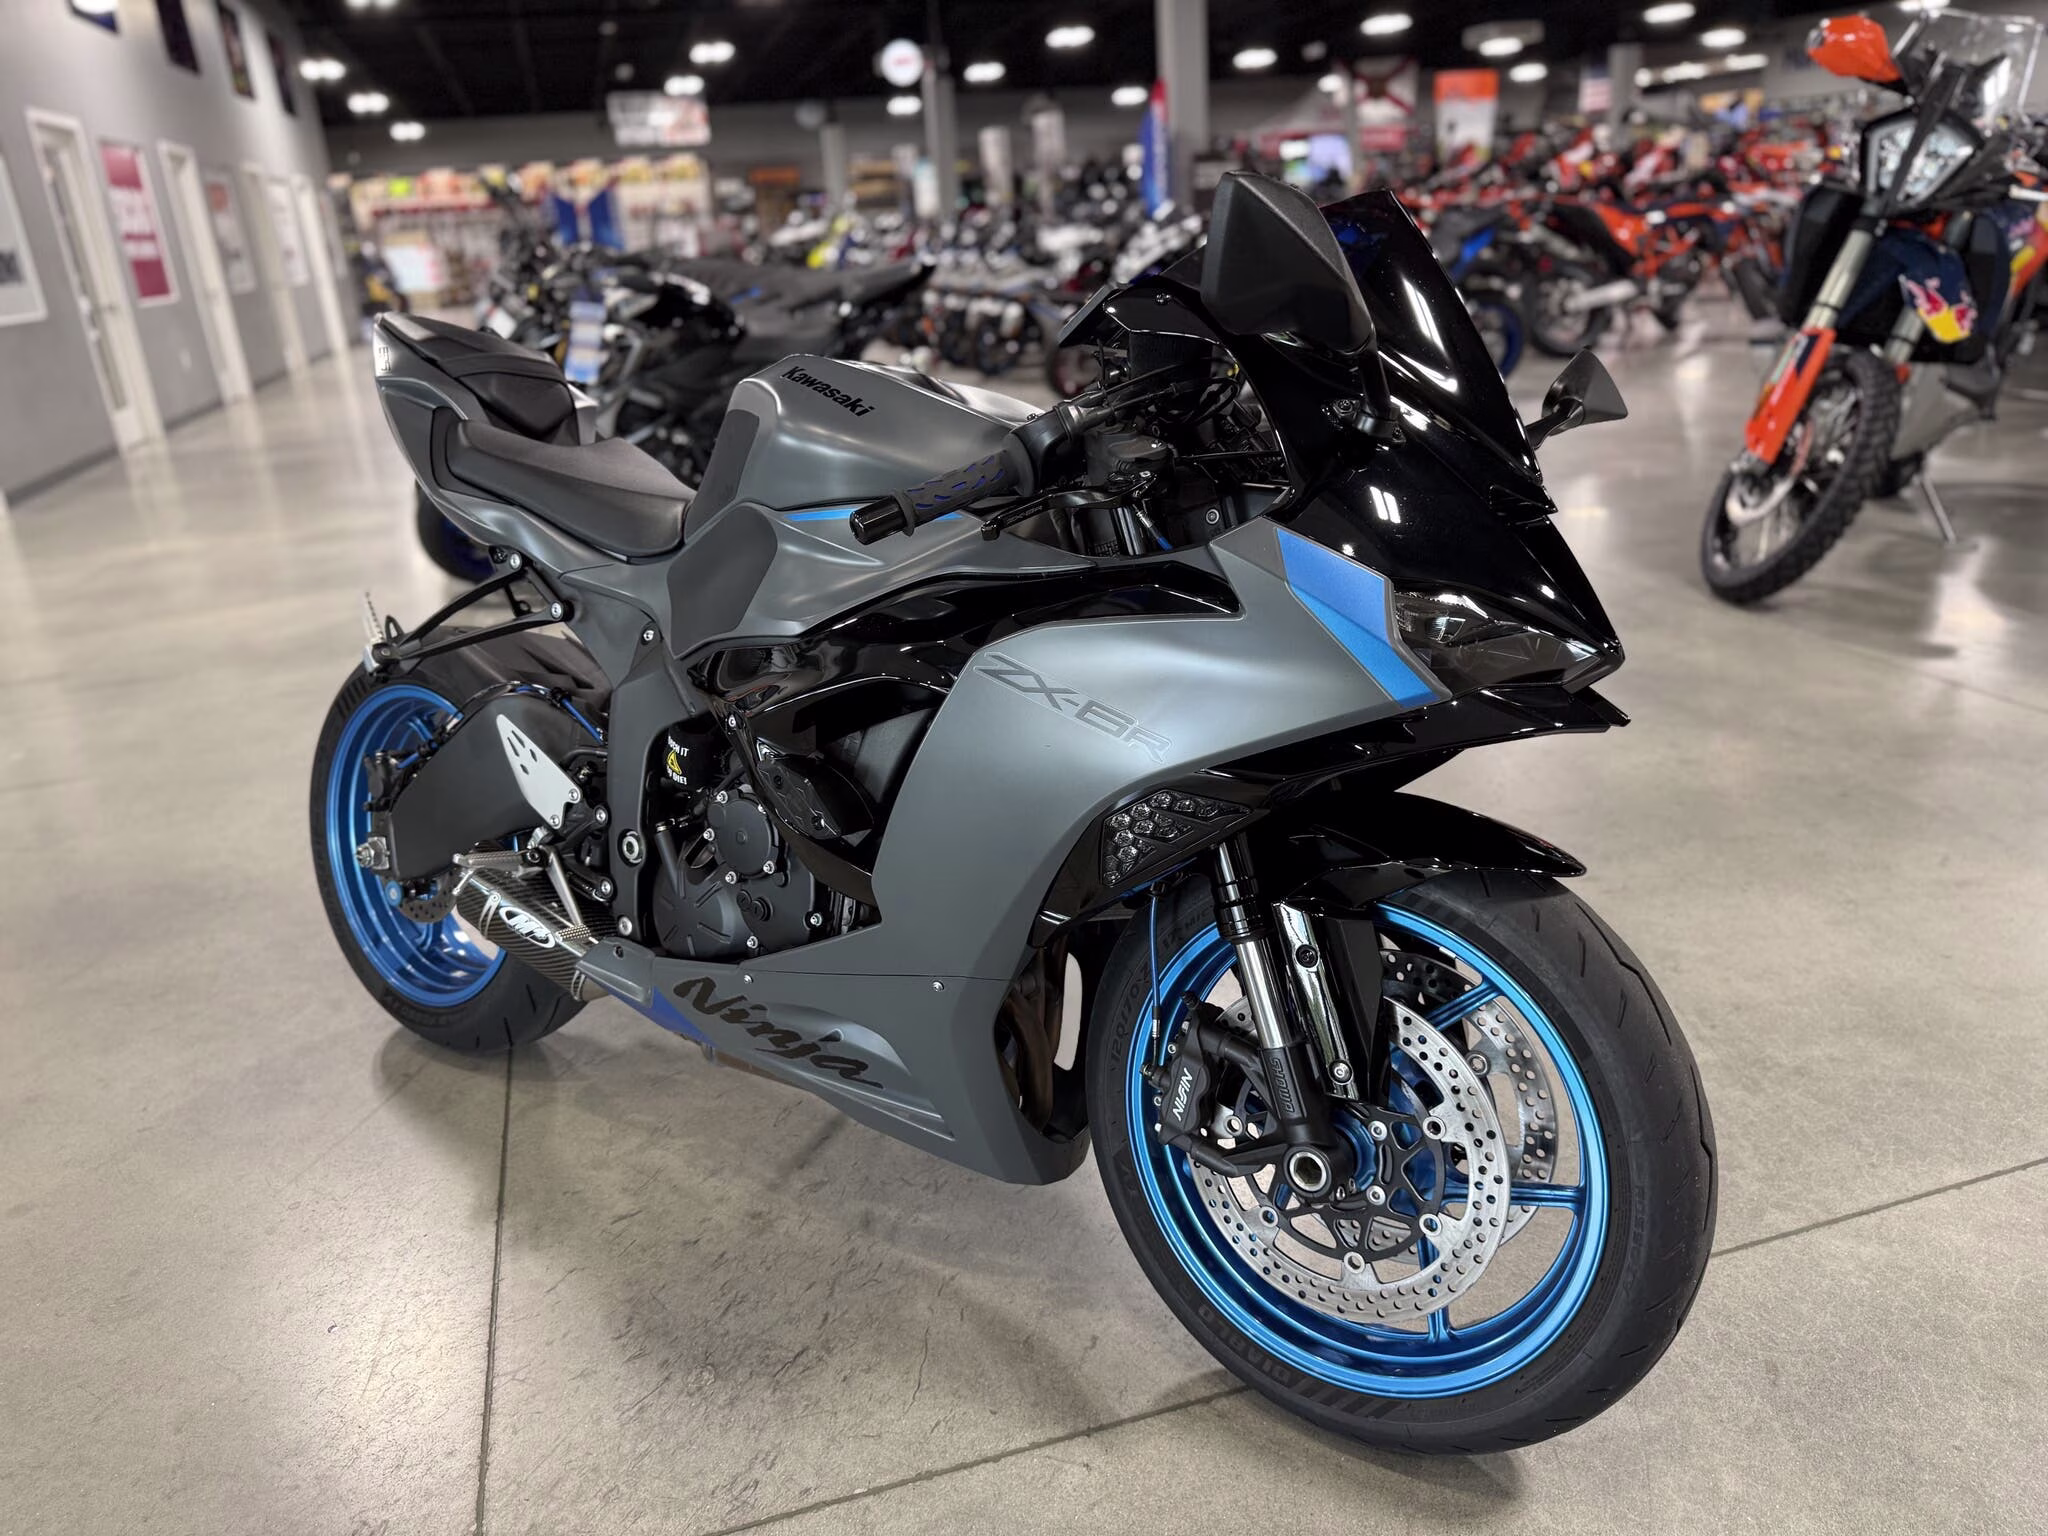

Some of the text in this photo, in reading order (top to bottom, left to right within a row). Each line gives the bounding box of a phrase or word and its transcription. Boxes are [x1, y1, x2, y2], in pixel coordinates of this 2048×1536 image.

[782, 366, 876, 417] Kawasaki
[974, 653, 1172, 763] ZX-6R
[680, 747, 689, 757] IT
[673, 977, 885, 1090] Ninja
[1269, 1056, 1295, 1113] SHOWA
